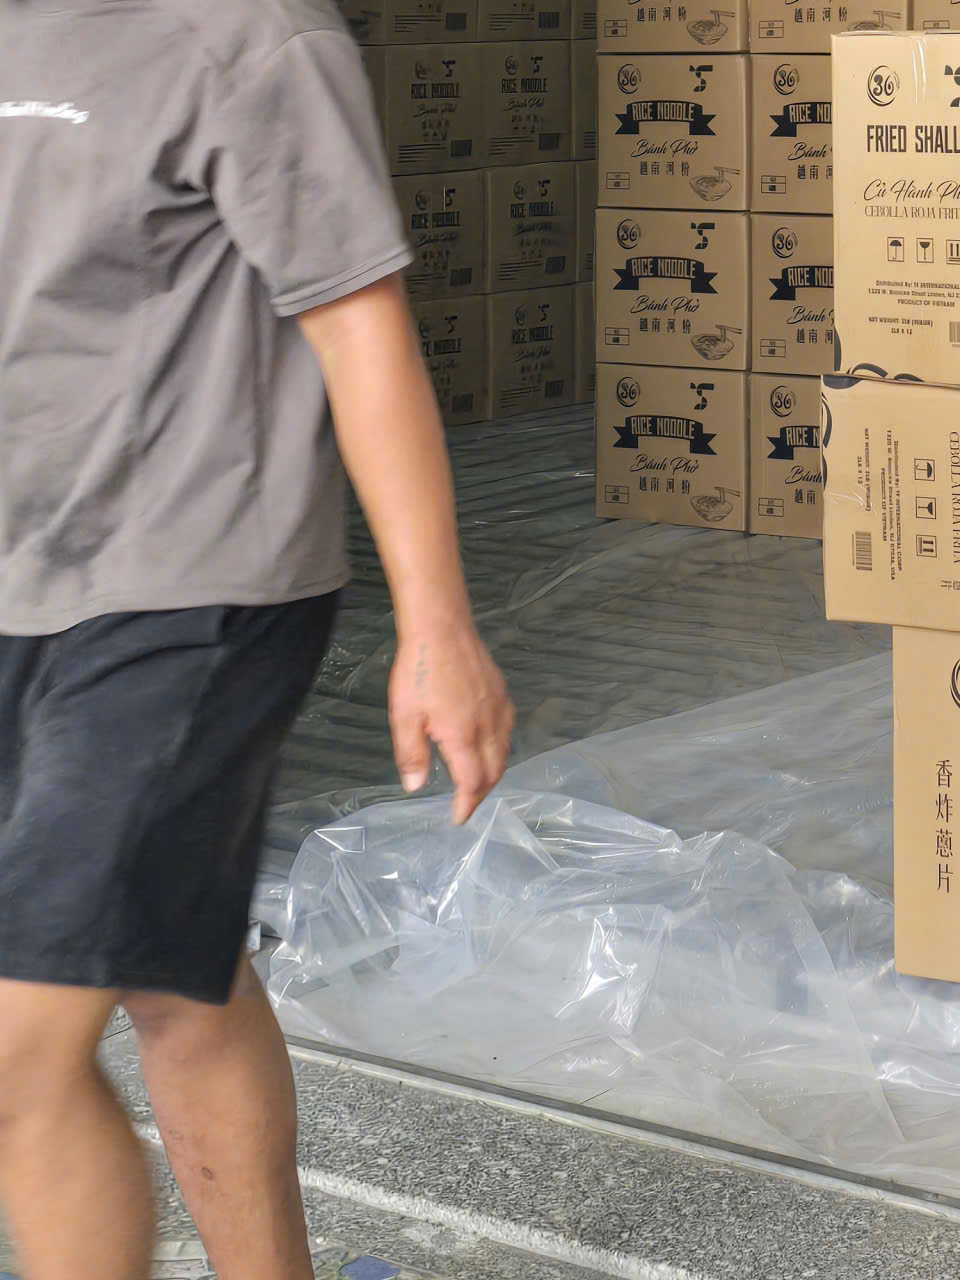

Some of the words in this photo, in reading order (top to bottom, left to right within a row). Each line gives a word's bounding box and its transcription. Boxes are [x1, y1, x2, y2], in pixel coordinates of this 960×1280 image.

[622, 72, 638, 86] 36
[778, 72, 796, 87] 36
[872, 74, 894, 96] 36
[632, 102, 653, 121] RICE
[658, 102, 694, 120] NOODLE
[790, 104, 812, 122] RICE
[867, 124, 907, 152] FRIED
[890, 180, 932, 204] Hành
[864, 205, 908, 218] CEBOLLA
[621, 226, 637, 240] 36
[778, 236, 794, 251] 36
[632, 260, 653, 277] RICE
[658, 260, 696, 278] NOODLE
[788, 268, 810, 286] RICE
[622, 386, 637, 400] 36
[775, 392, 792, 408] 36
[631, 416, 652, 435] RICE
[656, 417, 696, 439] NOODLE
[786, 427, 808, 446] RICE
